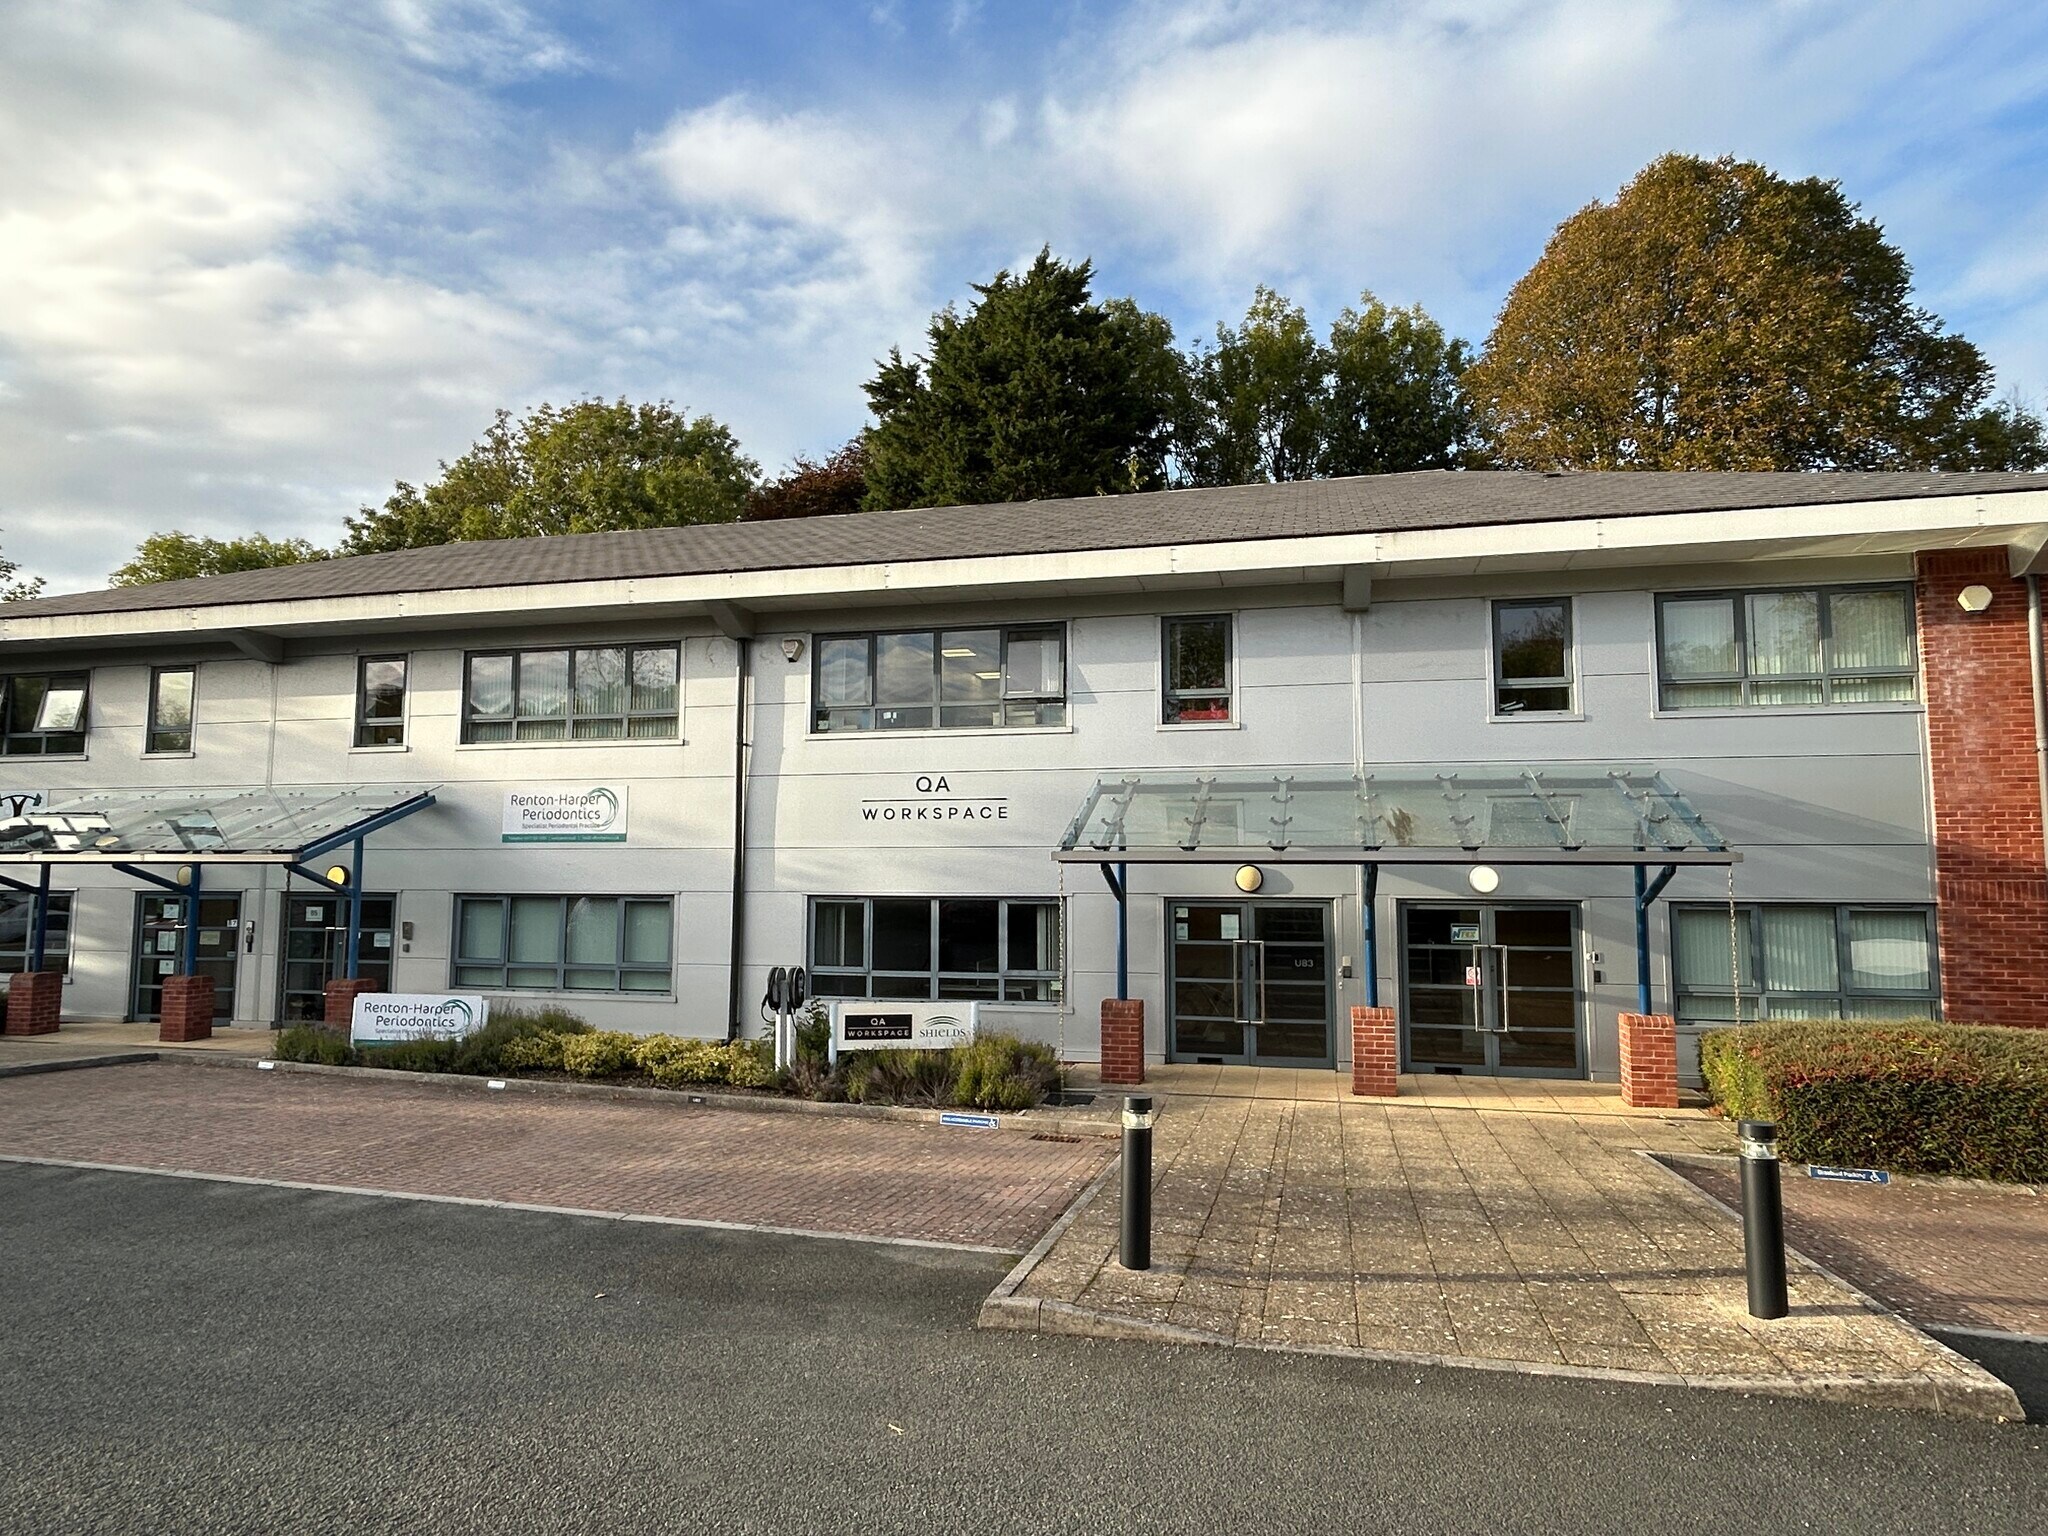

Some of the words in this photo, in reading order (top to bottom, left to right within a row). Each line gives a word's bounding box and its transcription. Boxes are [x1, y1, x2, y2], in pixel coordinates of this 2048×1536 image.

[916, 776, 950, 793] QA
[510, 794, 600, 807] Renton-Harper
[522, 808, 601, 820] Periodontics
[862, 806, 1008, 820] WORKSPACE
[1294, 959, 1314, 968] U83
[364, 1002, 455, 1016] Renton-Harper
[375, 1015, 456, 1027] Periodontics
[870, 1018, 886, 1026] QA
[847, 1029, 909, 1037] WORKSPACE
